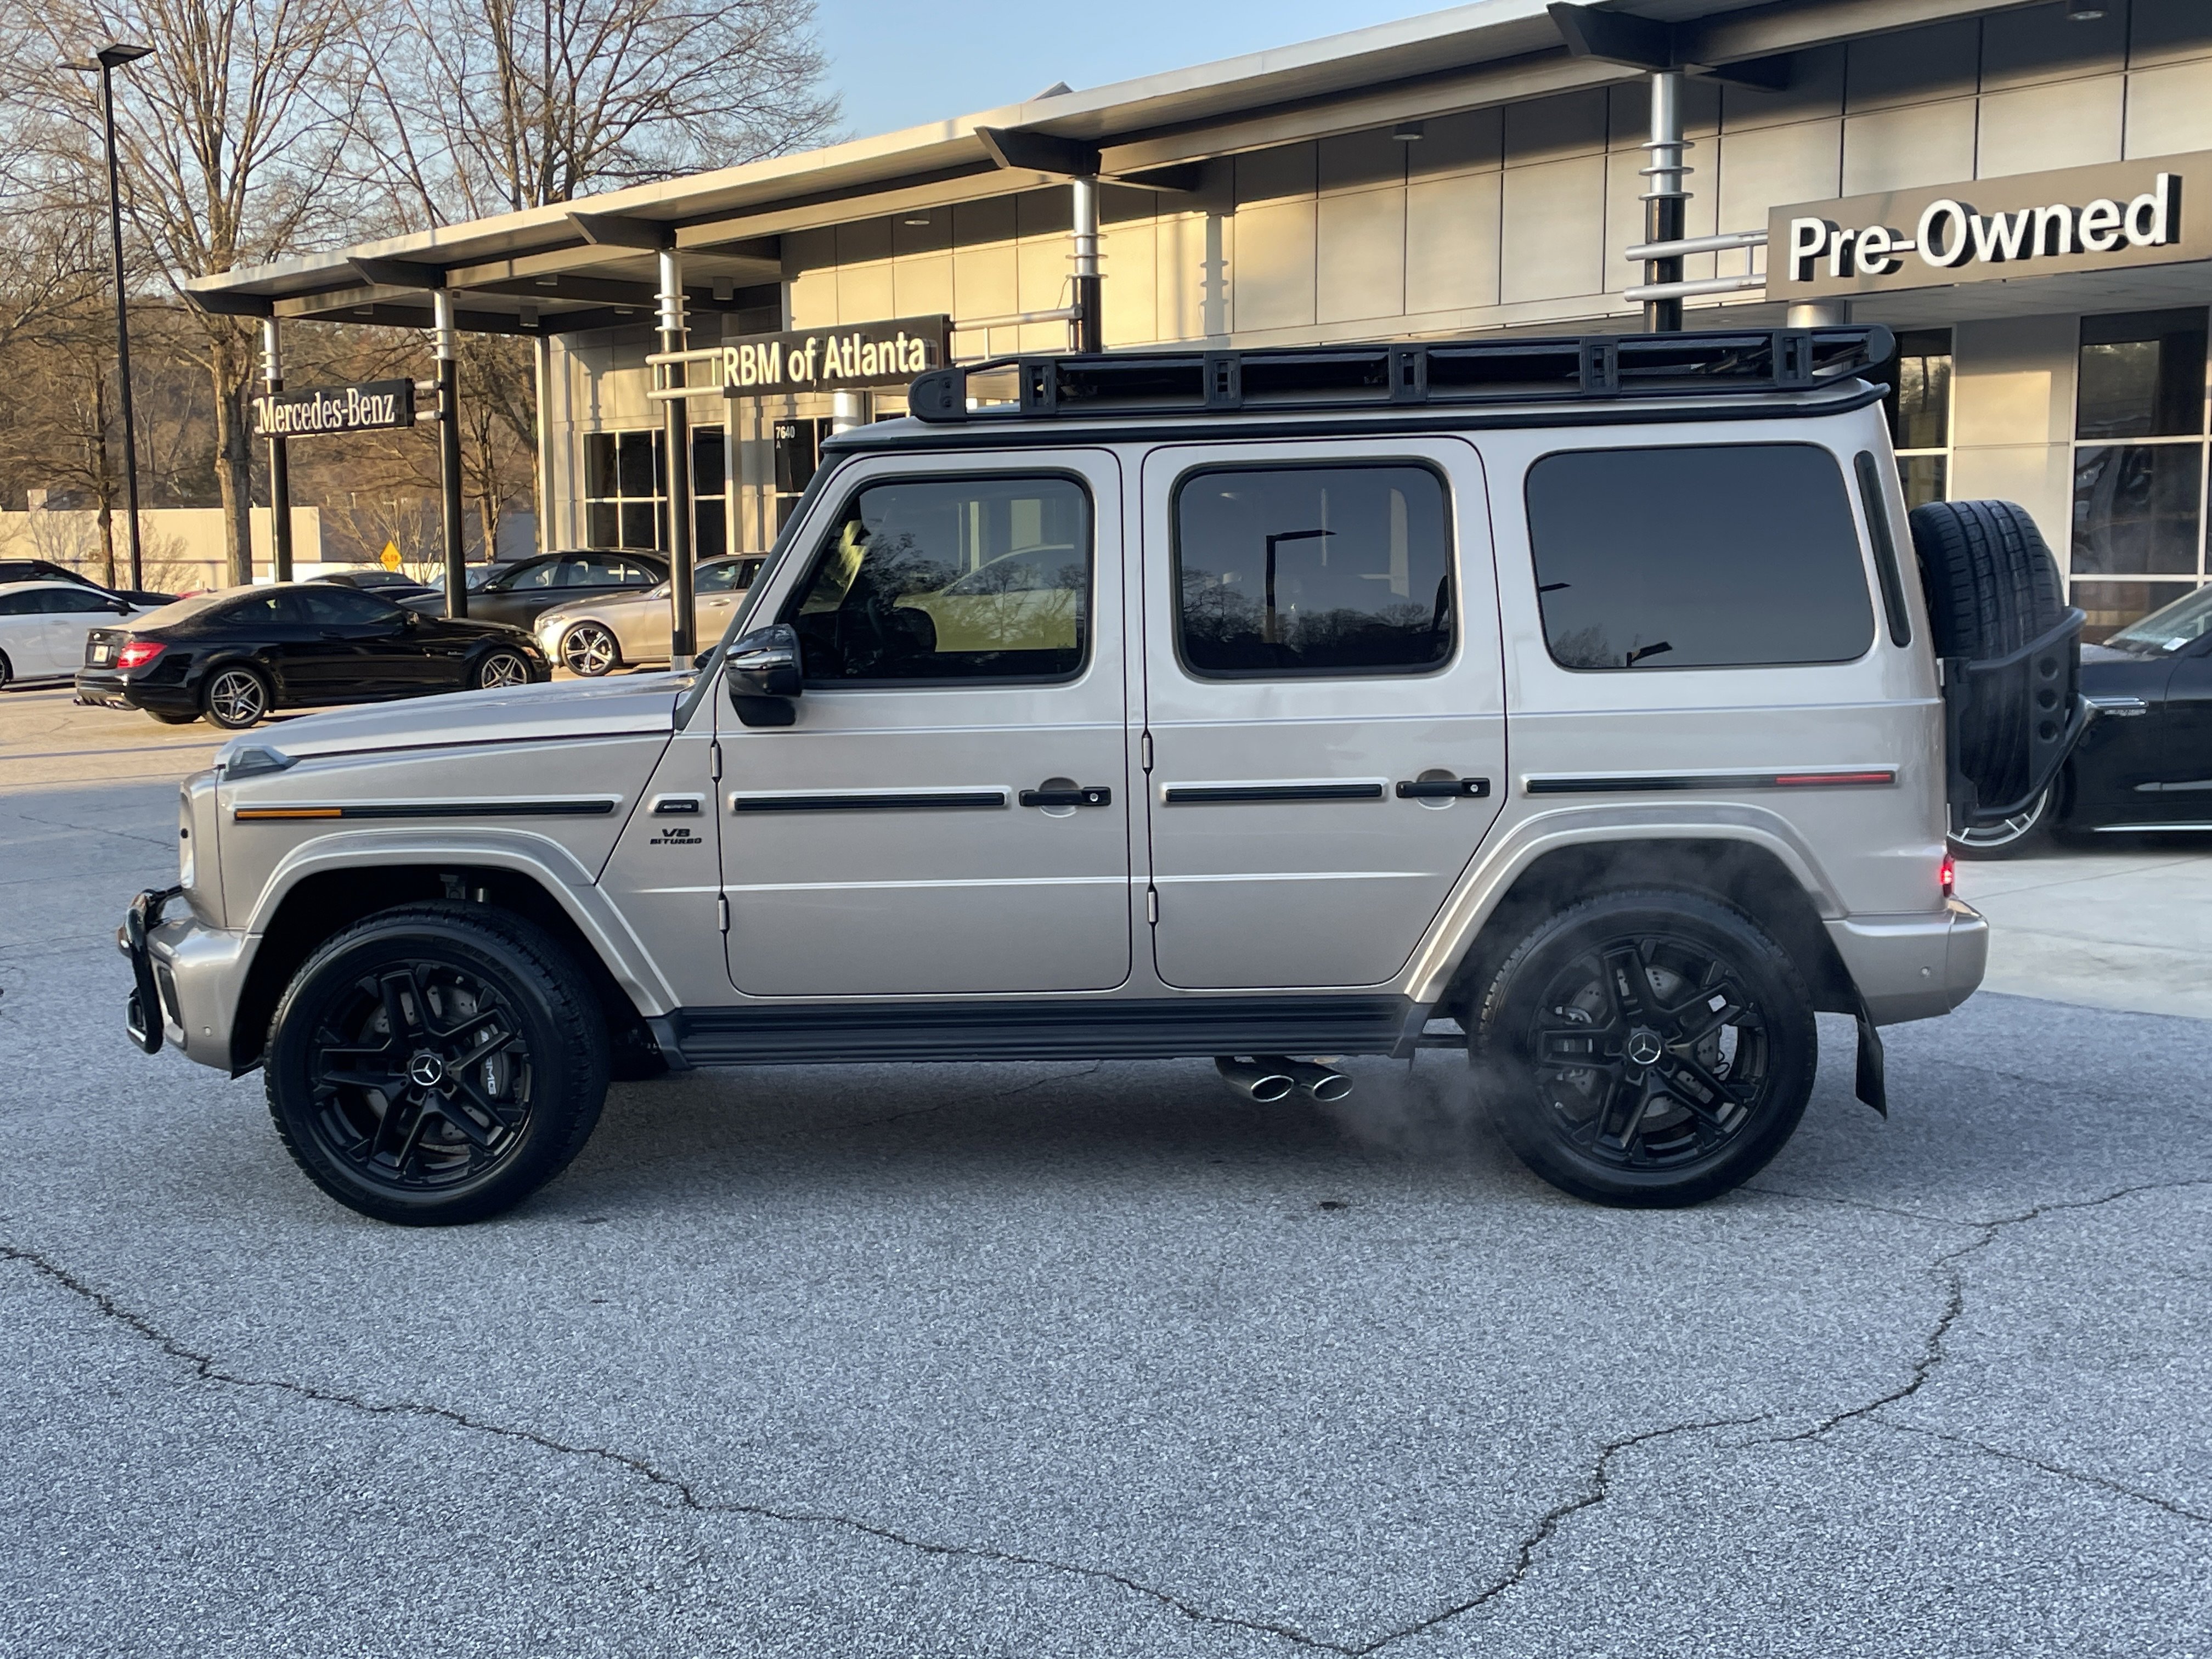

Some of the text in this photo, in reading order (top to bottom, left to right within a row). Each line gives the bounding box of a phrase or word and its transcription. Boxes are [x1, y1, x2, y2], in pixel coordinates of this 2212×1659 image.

[1790, 172, 2179, 281] Pre-Owned
[723, 331, 926, 387] RBM of Atlanta
[258, 387, 395, 433] Mercedes-Benz
[775, 425, 795, 439] 7640
[662, 828, 691, 837] V8
